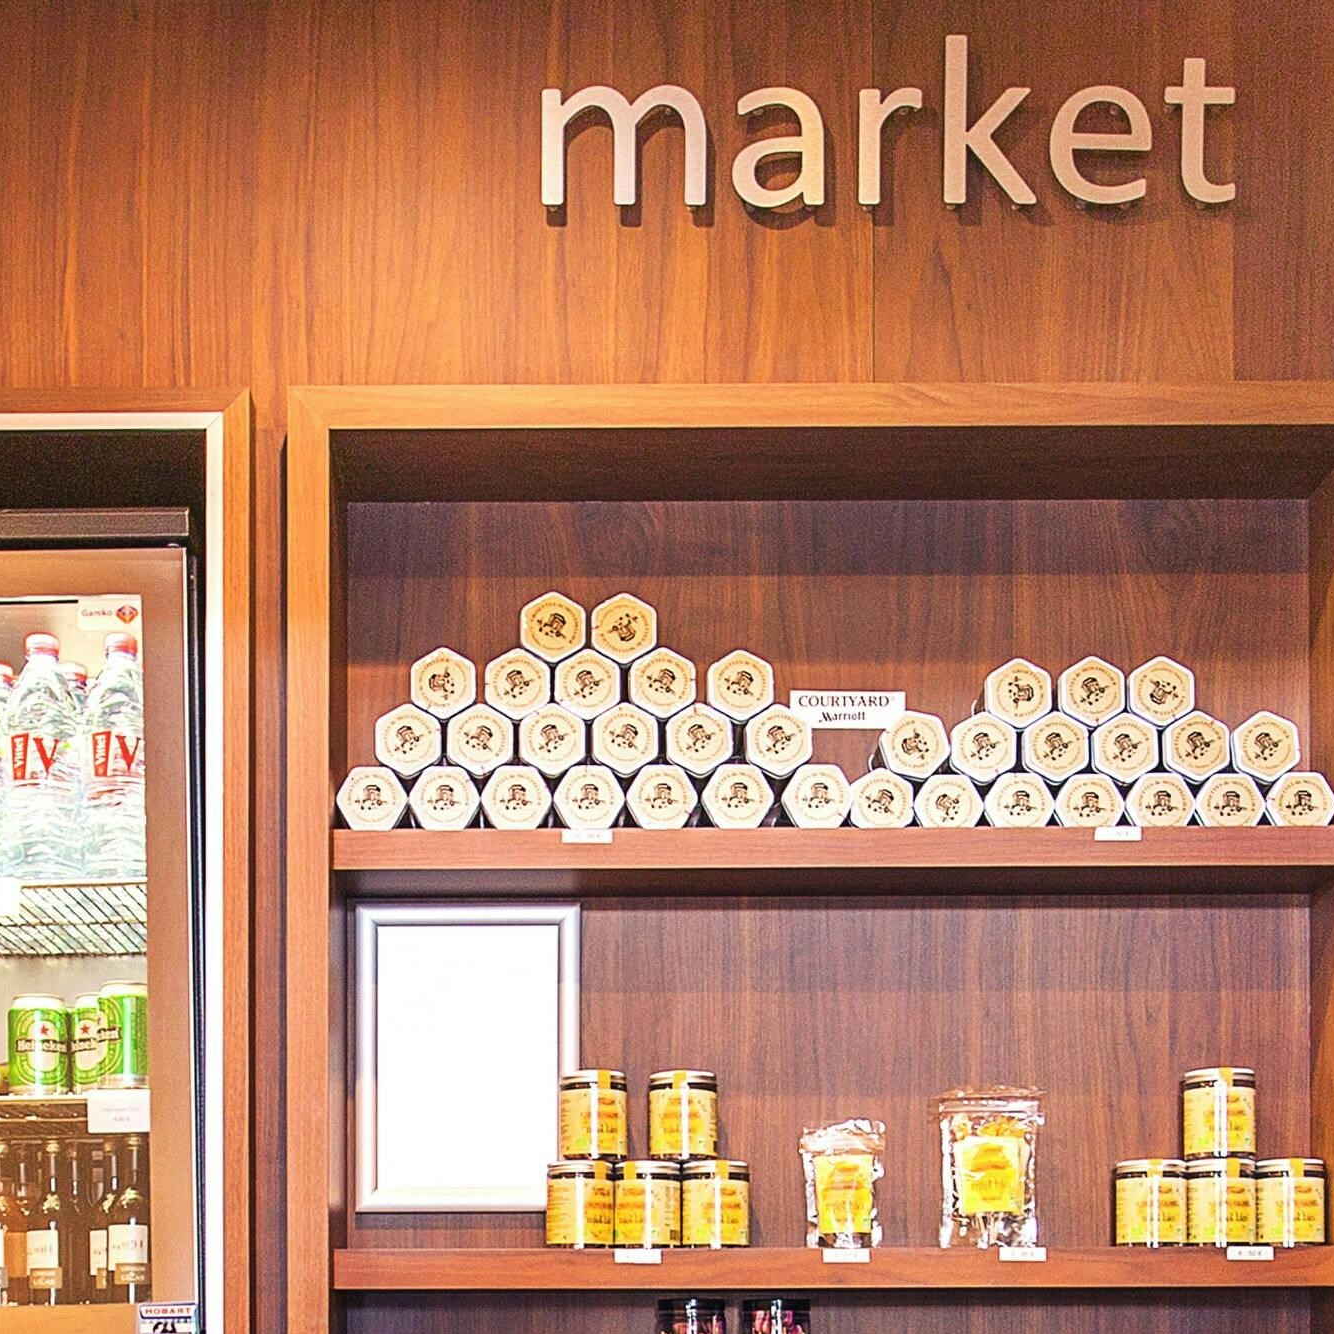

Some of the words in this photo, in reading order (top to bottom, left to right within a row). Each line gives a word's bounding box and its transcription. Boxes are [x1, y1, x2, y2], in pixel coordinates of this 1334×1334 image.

[541, 34, 1236, 208] market
[798, 695, 890, 708] COURTYARD
[818, 711, 866, 723] Marriott
[144, 1307, 192, 1315] HOBART
